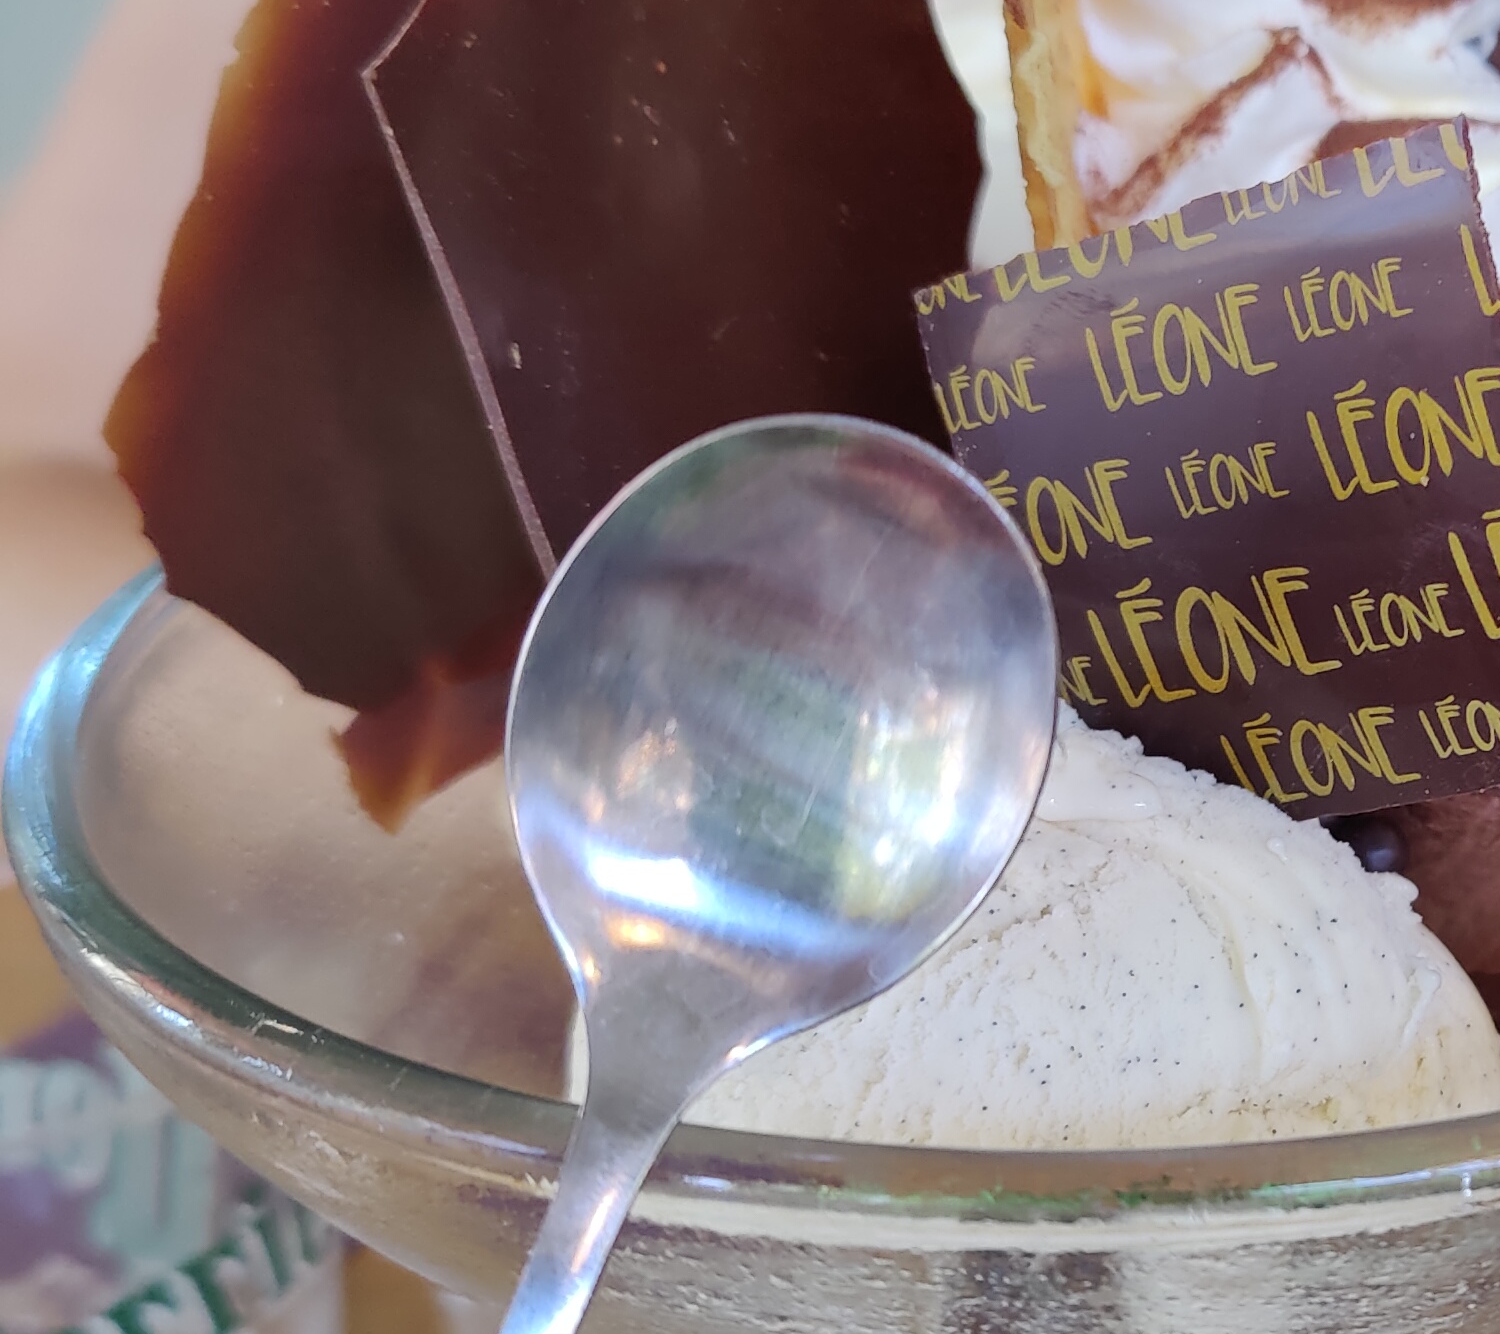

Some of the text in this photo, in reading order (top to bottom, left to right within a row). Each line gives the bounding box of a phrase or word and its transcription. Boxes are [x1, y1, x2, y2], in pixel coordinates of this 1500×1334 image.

[933, 356, 1047, 434] LÉONE
[1085, 282, 1279, 412] LÉONE
[1283, 256, 1414, 343] LÉONE
[1164, 441, 1291, 519] LÉONE
[1087, 566, 1343, 708] LÉONE
[1333, 582, 1465, 656] LÉONE
[1219, 706, 1422, 804] LÉONE
